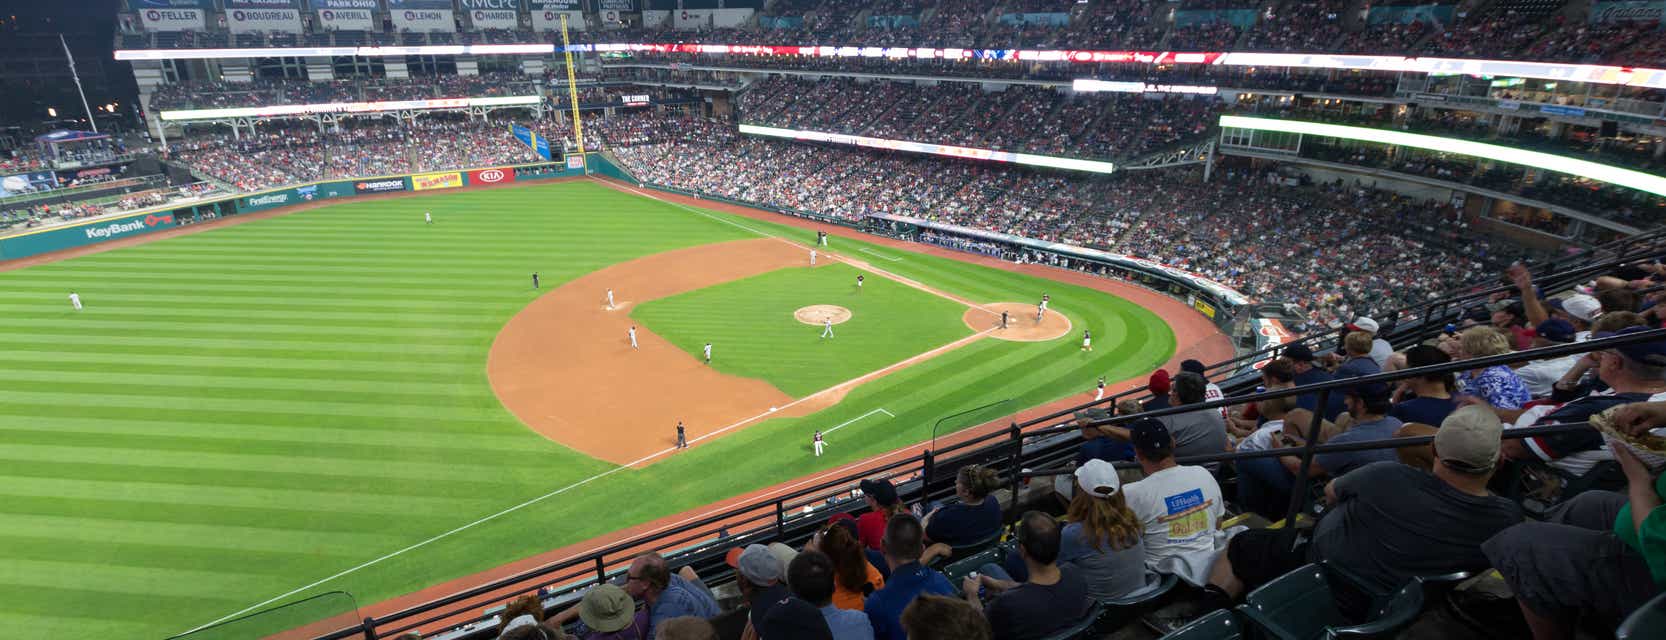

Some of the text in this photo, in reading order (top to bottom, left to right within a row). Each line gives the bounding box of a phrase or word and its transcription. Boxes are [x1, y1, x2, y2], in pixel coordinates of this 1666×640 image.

[161, 11, 197, 21] FELLER
[247, 11, 294, 21] BOUDREAU
[335, 11, 368, 20] AVERILL
[415, 11, 442, 20] LEMON
[485, 12, 514, 20] HARDER
[622, 95, 631, 103] THE
[483, 171, 500, 180] KIA
[85, 220, 145, 239] KeyBank
